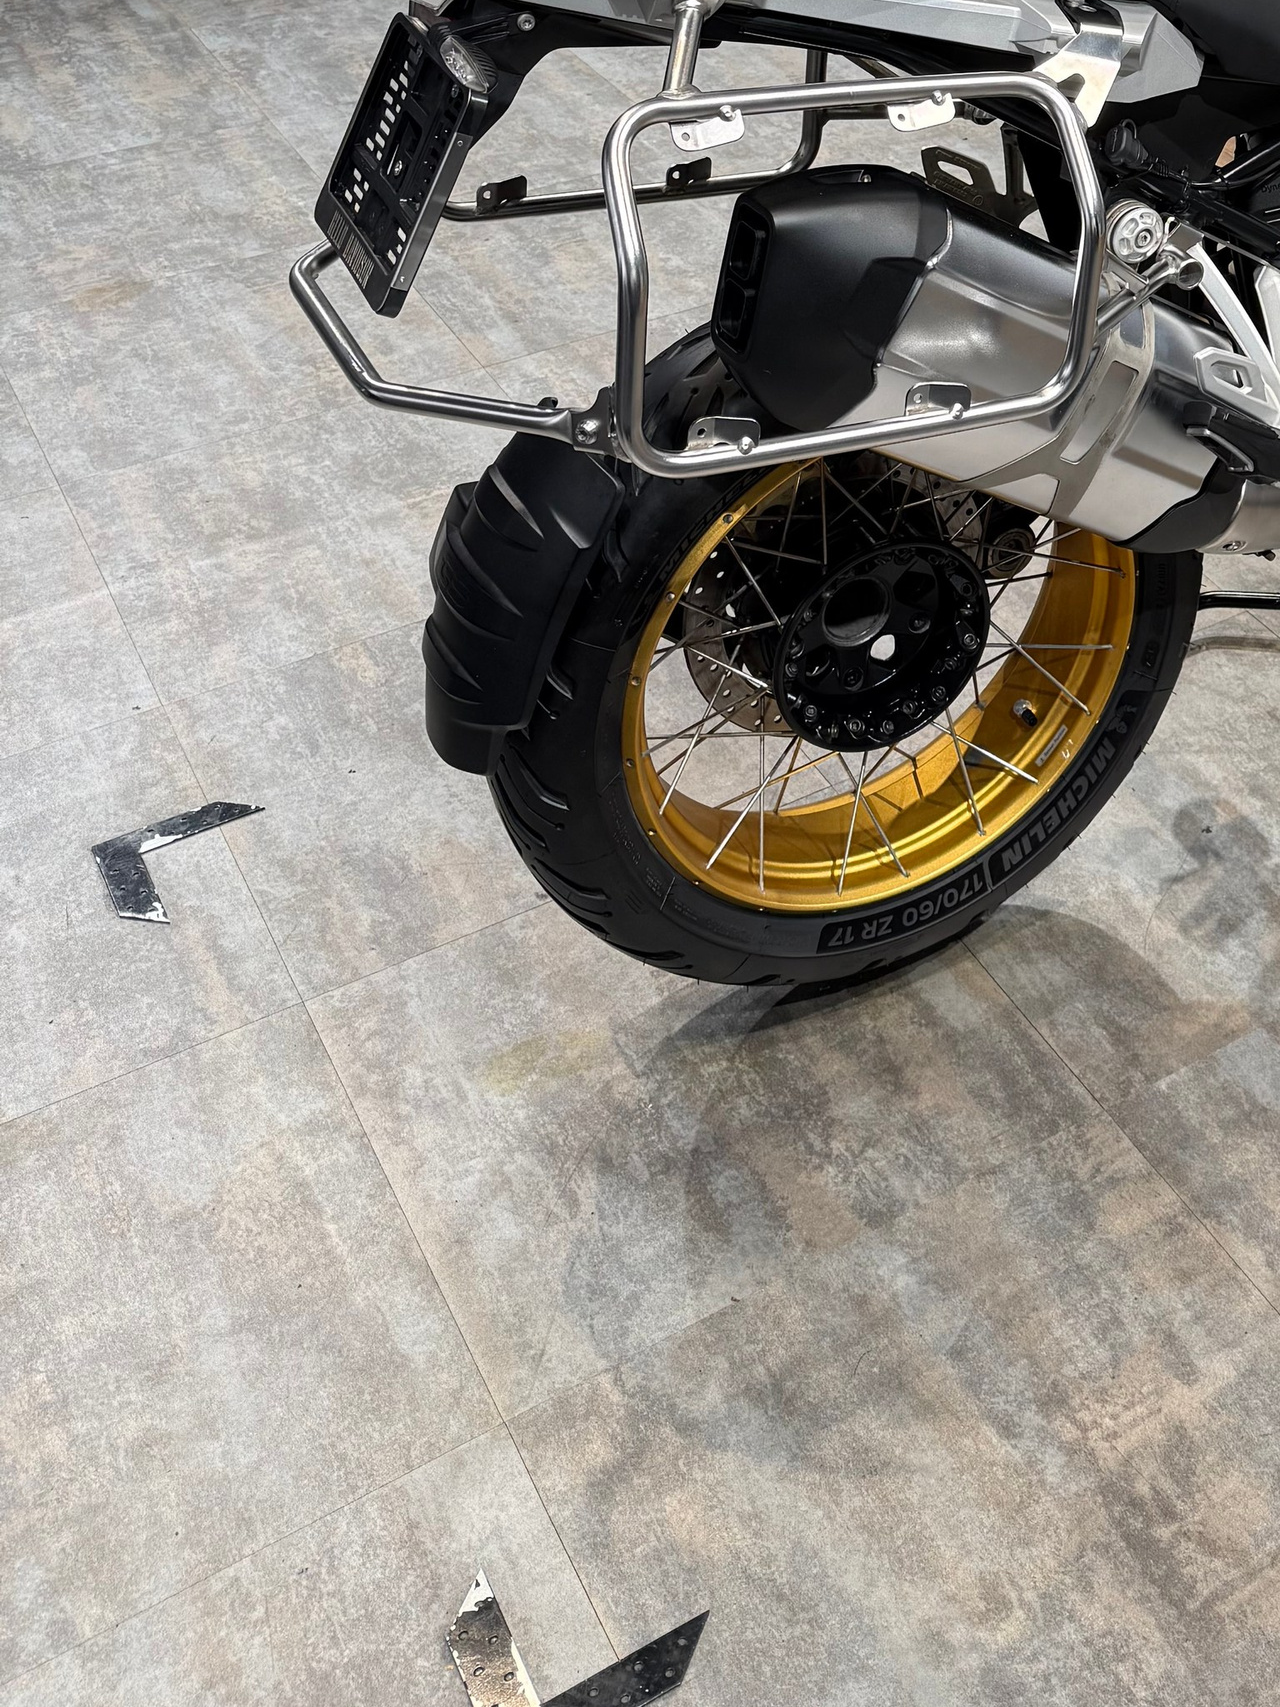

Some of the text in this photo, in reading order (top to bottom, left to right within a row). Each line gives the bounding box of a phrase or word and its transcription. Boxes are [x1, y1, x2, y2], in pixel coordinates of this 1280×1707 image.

[1001, 735, 1119, 873] MICHELIN
[828, 870, 984, 947] 170/60 ZR 17
